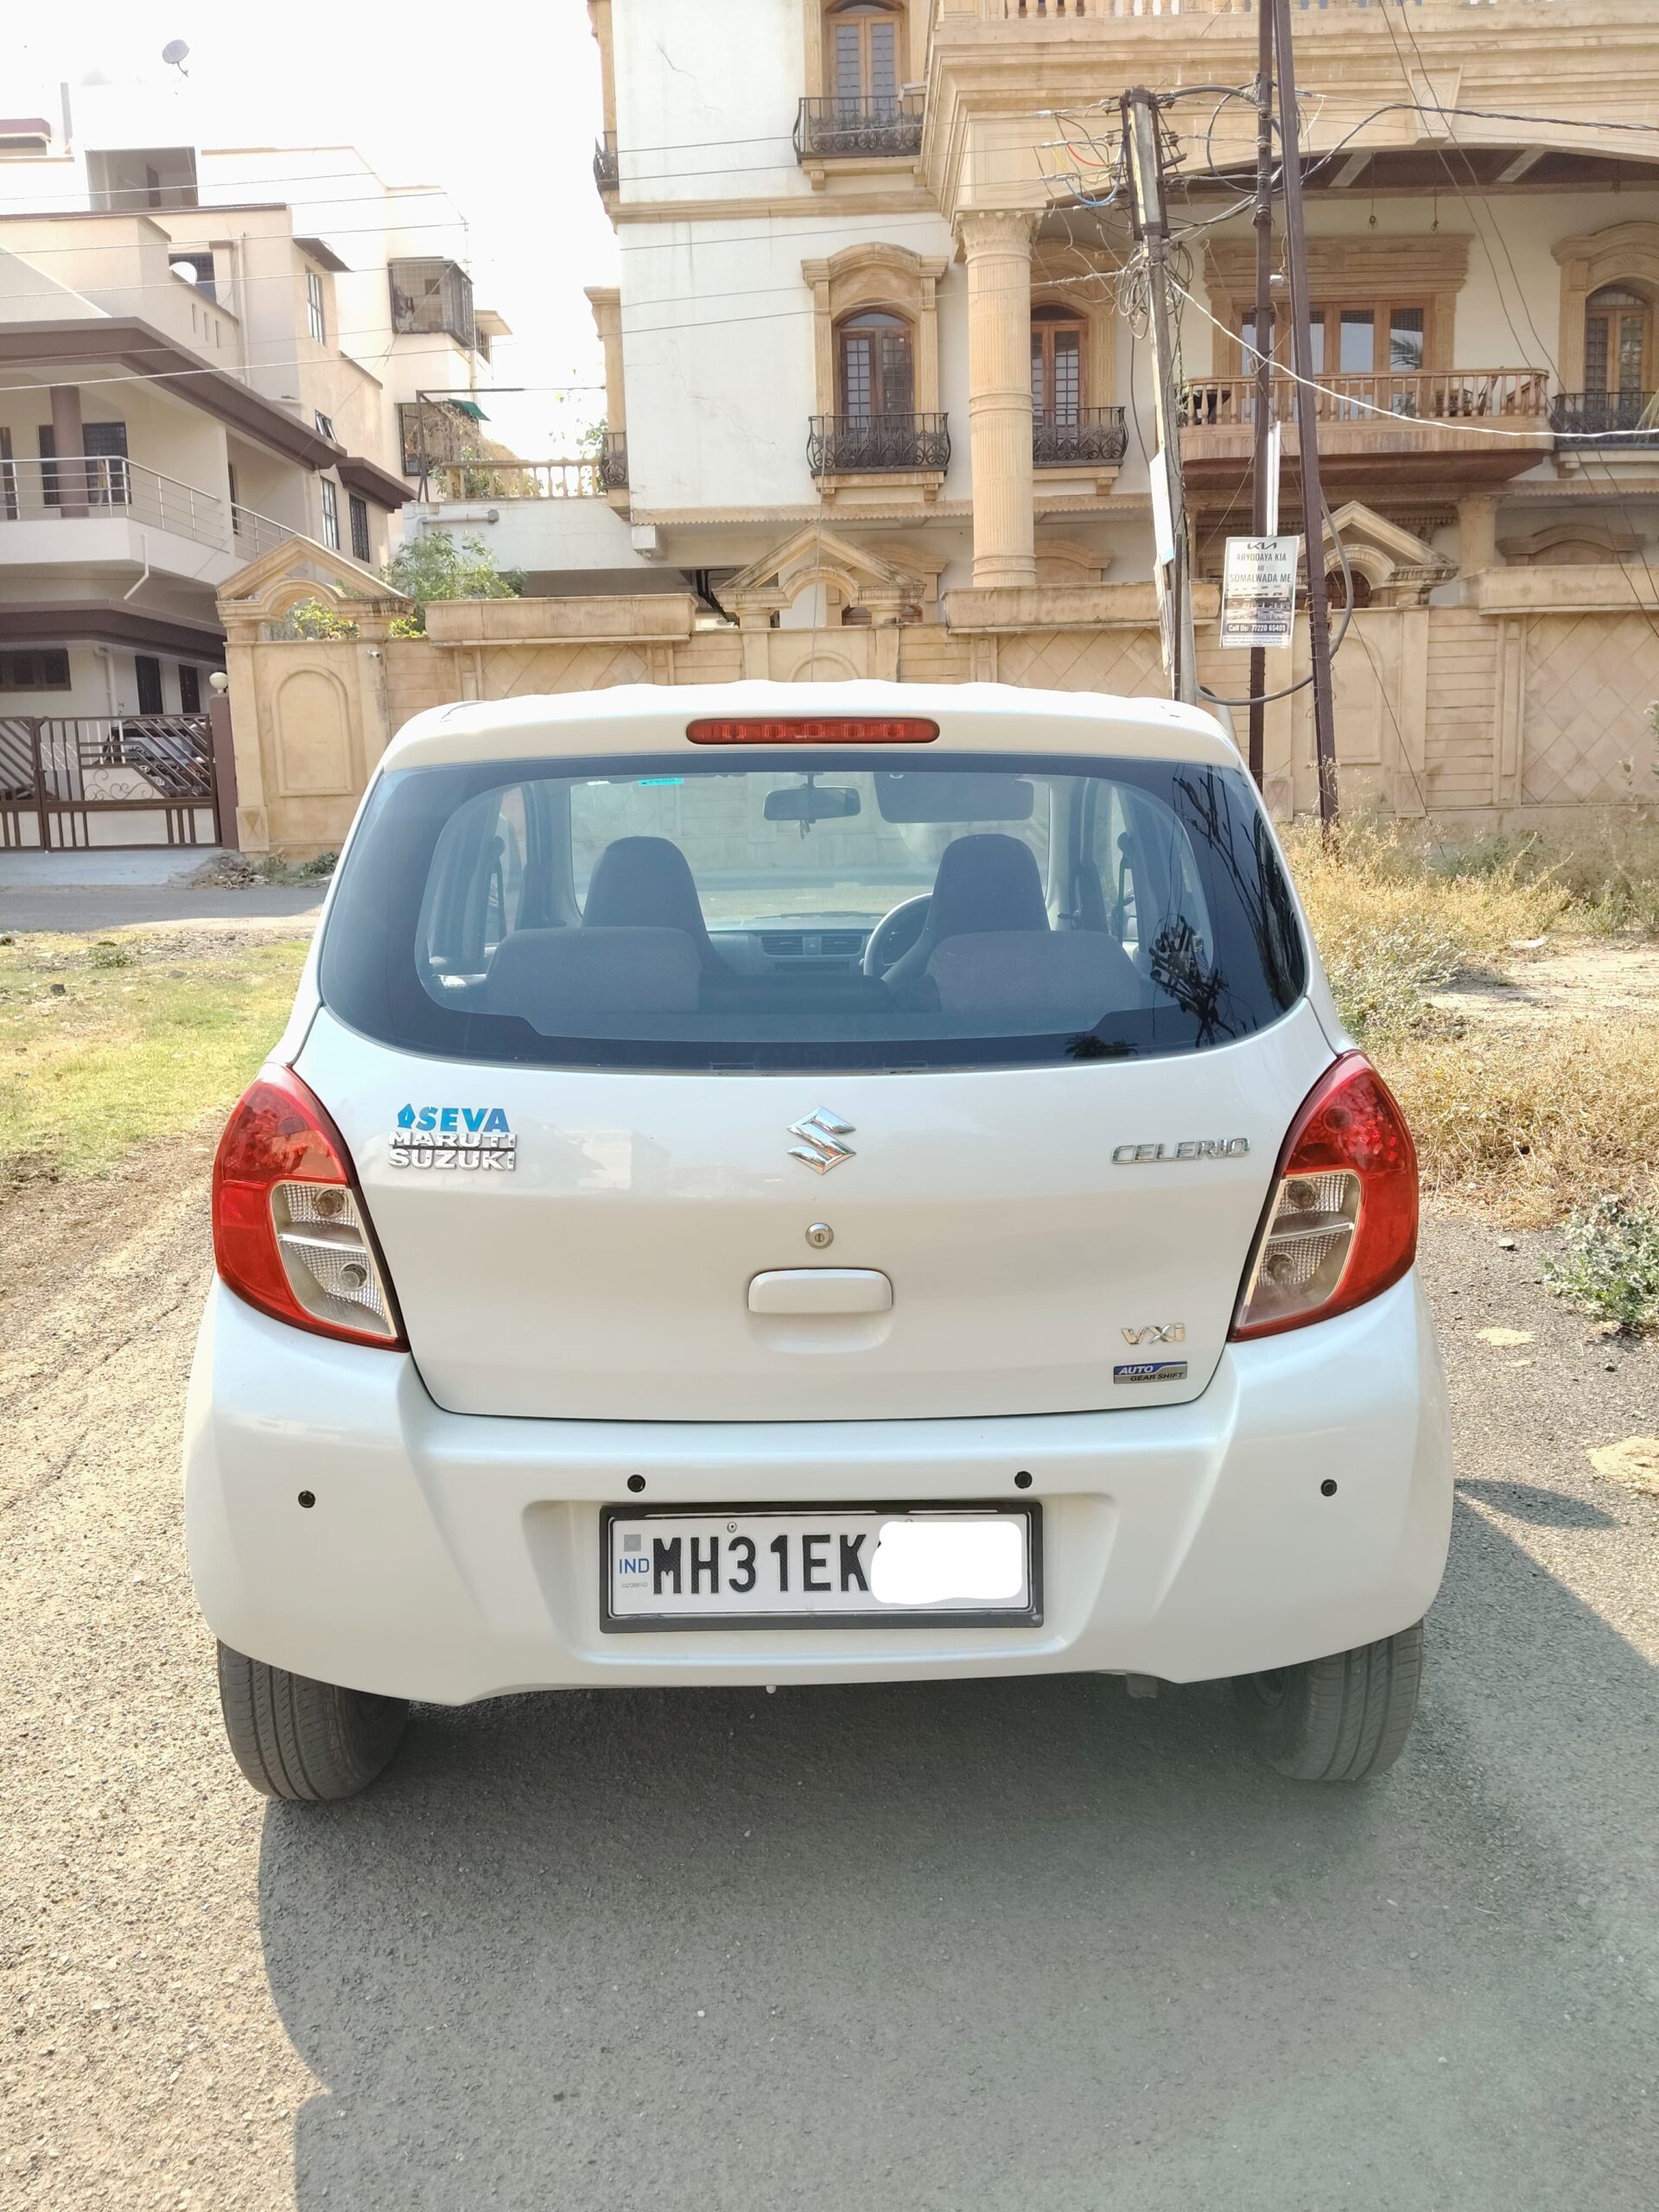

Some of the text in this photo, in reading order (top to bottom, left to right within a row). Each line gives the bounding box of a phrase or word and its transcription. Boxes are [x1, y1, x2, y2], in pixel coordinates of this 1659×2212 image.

[1236, 553, 1287, 562] ARYODAYA KIA
[1230, 573, 1292, 583] SOMALWADA ME
[415, 1106, 511, 1133] SEVA
[389, 1131, 517, 1148] MARUTI
[389, 1147, 516, 1170] SUZUKI
[1110, 1137, 1250, 1164] CELERIO
[1118, 1365, 1154, 1375] AUTO
[620, 1558, 650, 1574] IND
[653, 1534, 881, 1594] MH31EK
